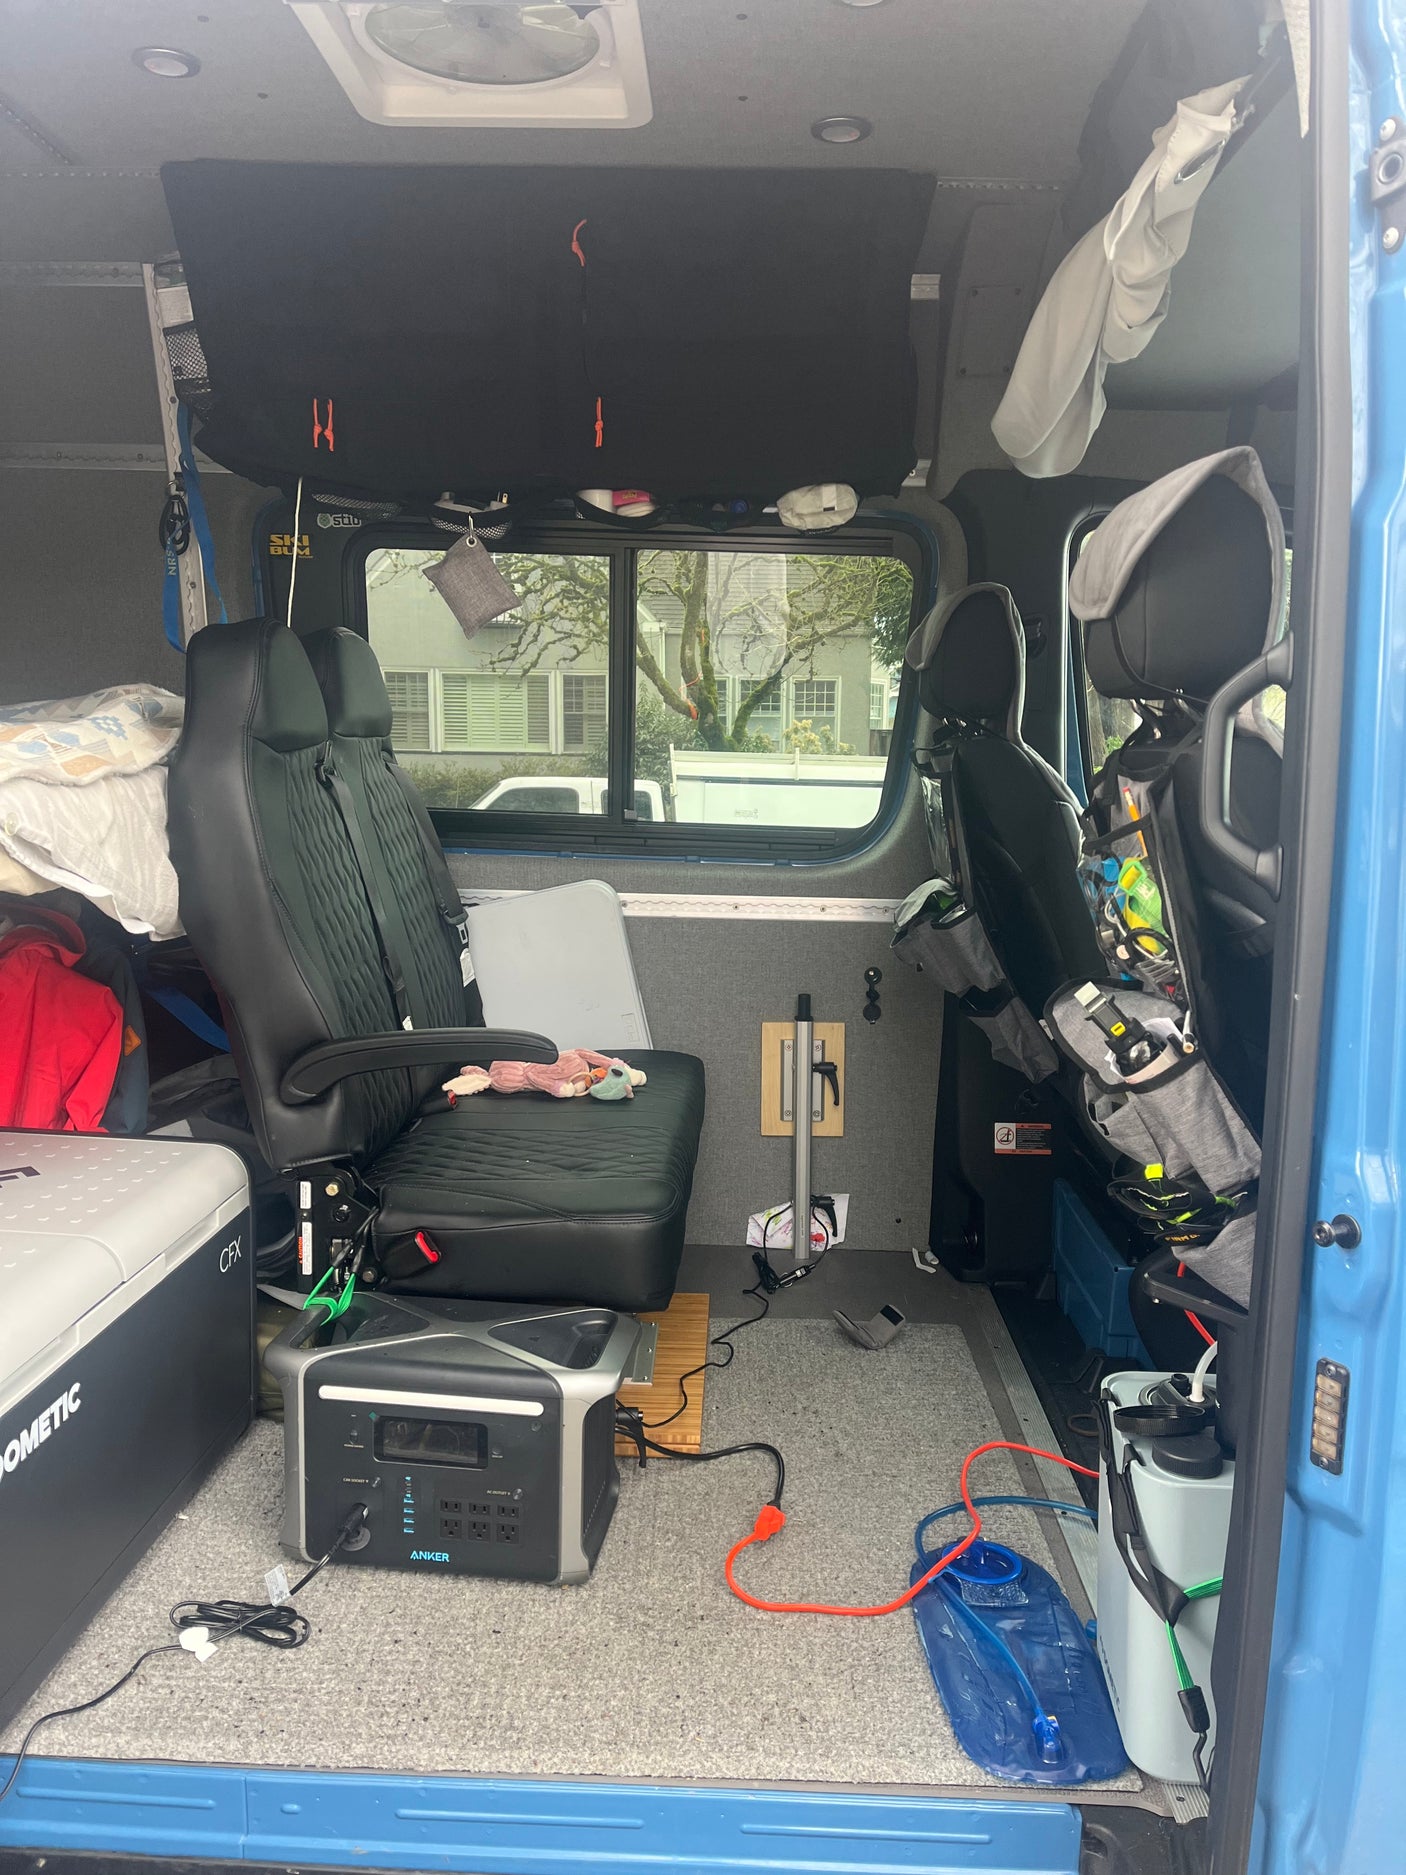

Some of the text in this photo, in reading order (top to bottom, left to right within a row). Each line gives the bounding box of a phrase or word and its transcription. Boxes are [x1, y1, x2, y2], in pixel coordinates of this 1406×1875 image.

[270, 534, 309, 546] SKI
[269, 546, 310, 555] BUM
[219, 1235, 242, 1273] CFX
[410, 1550, 450, 1563] ANKER
